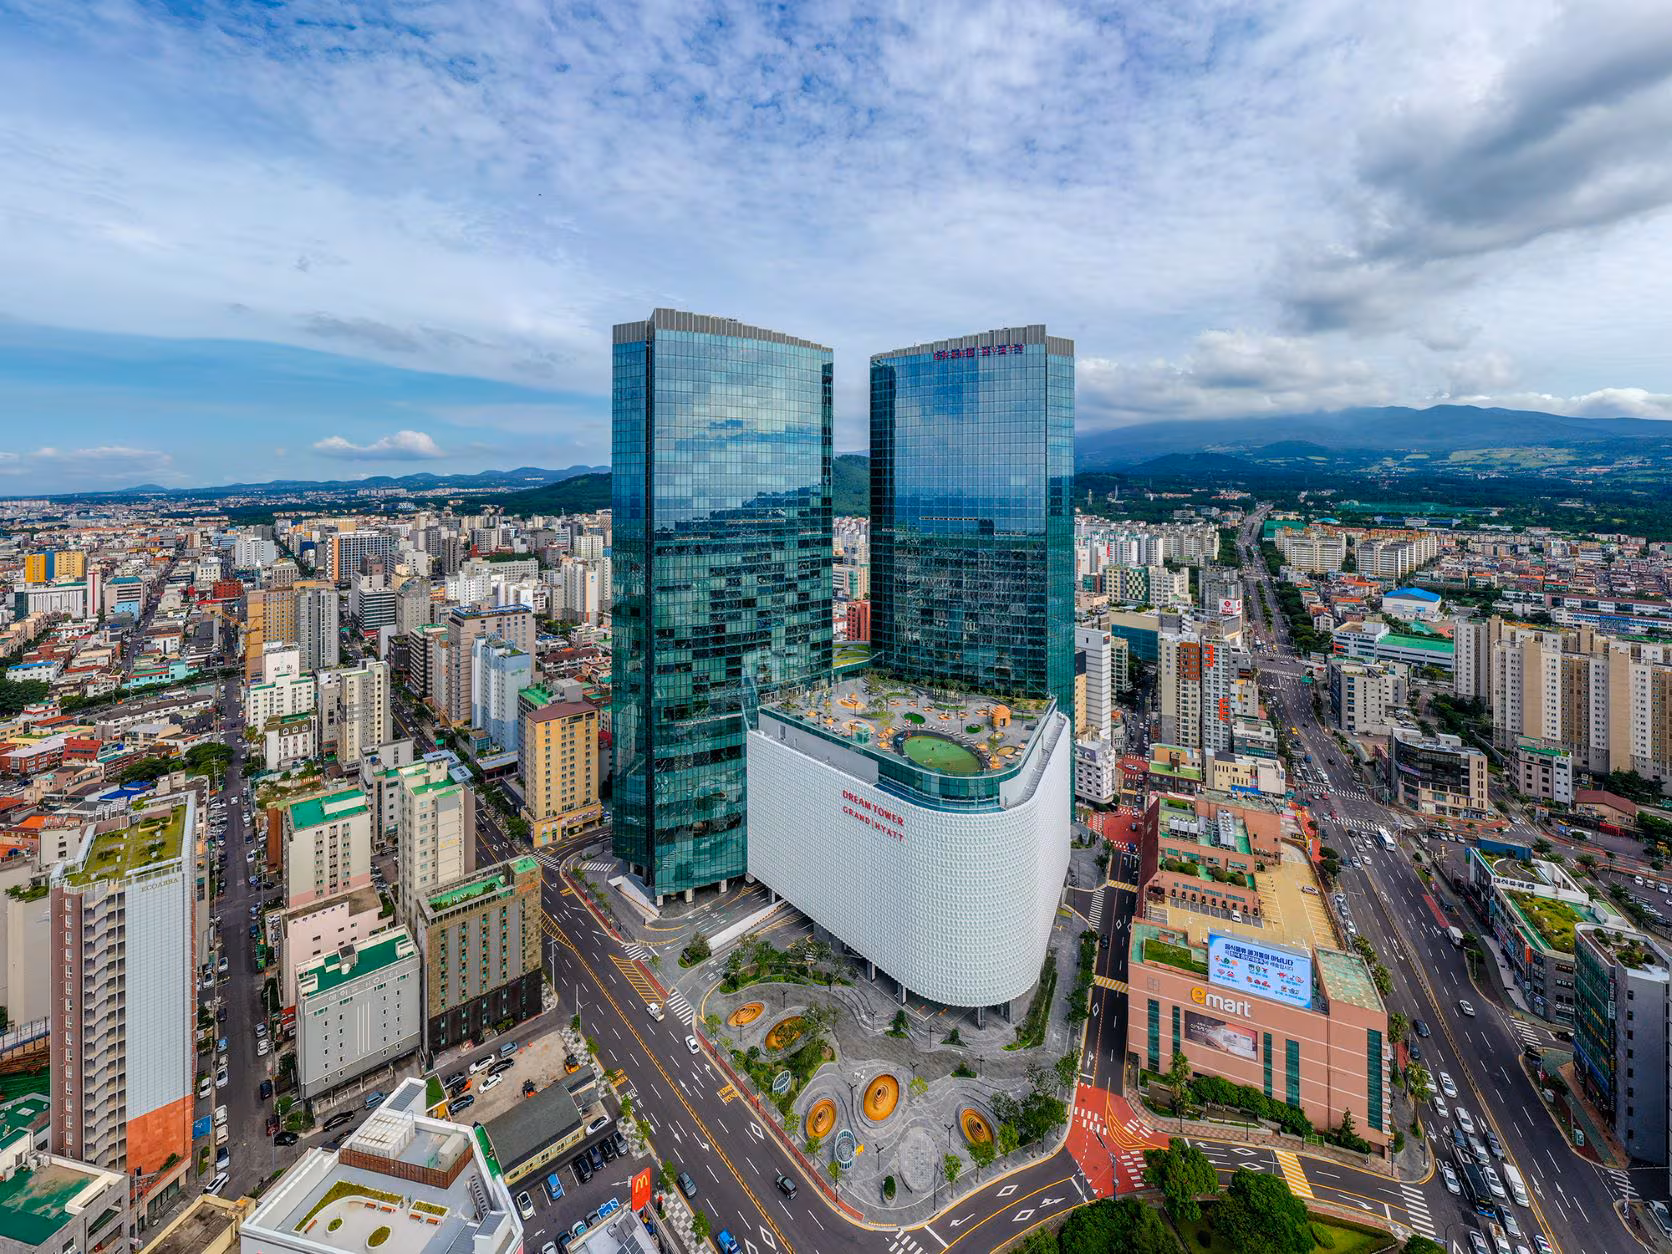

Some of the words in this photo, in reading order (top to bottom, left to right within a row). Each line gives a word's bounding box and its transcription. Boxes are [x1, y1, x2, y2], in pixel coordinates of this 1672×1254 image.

[842, 790, 871, 810] DREAM
[873, 803, 905, 826] TOWER
[842, 806, 870, 825] GRAND
[875, 822, 904, 842] HYATT
[1191, 986, 1251, 1018] emart
